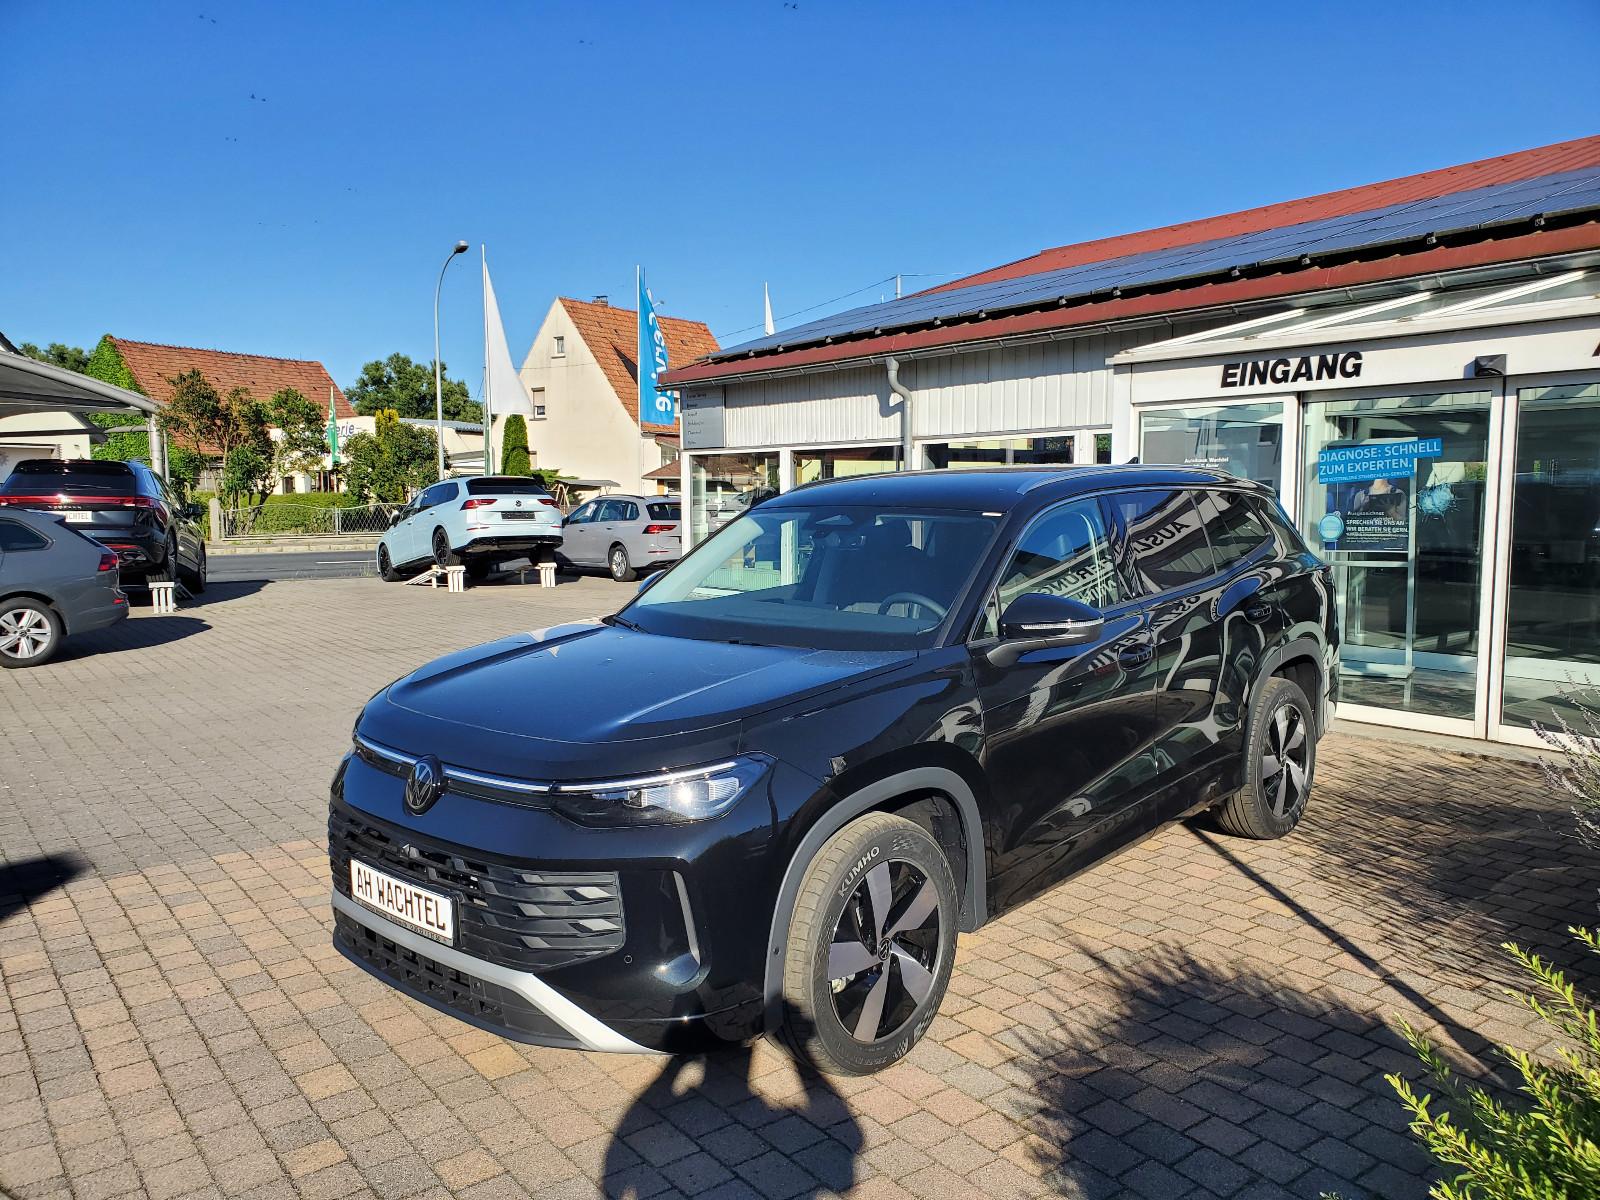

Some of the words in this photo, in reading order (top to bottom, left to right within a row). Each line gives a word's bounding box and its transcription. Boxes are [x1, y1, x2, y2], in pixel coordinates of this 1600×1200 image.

[1220, 350, 1363, 389] EINGANG
[1319, 447, 1382, 463] DIAGNOSE:
[1384, 440, 1441, 457] SCHNELL
[1319, 464, 1345, 476] ZUM
[1347, 458, 1413, 473] EXPERTEN.
[838, 846, 880, 898] KUMHO
[357, 867, 373, 899] AH
[376, 876, 446, 931] WACHTEL
